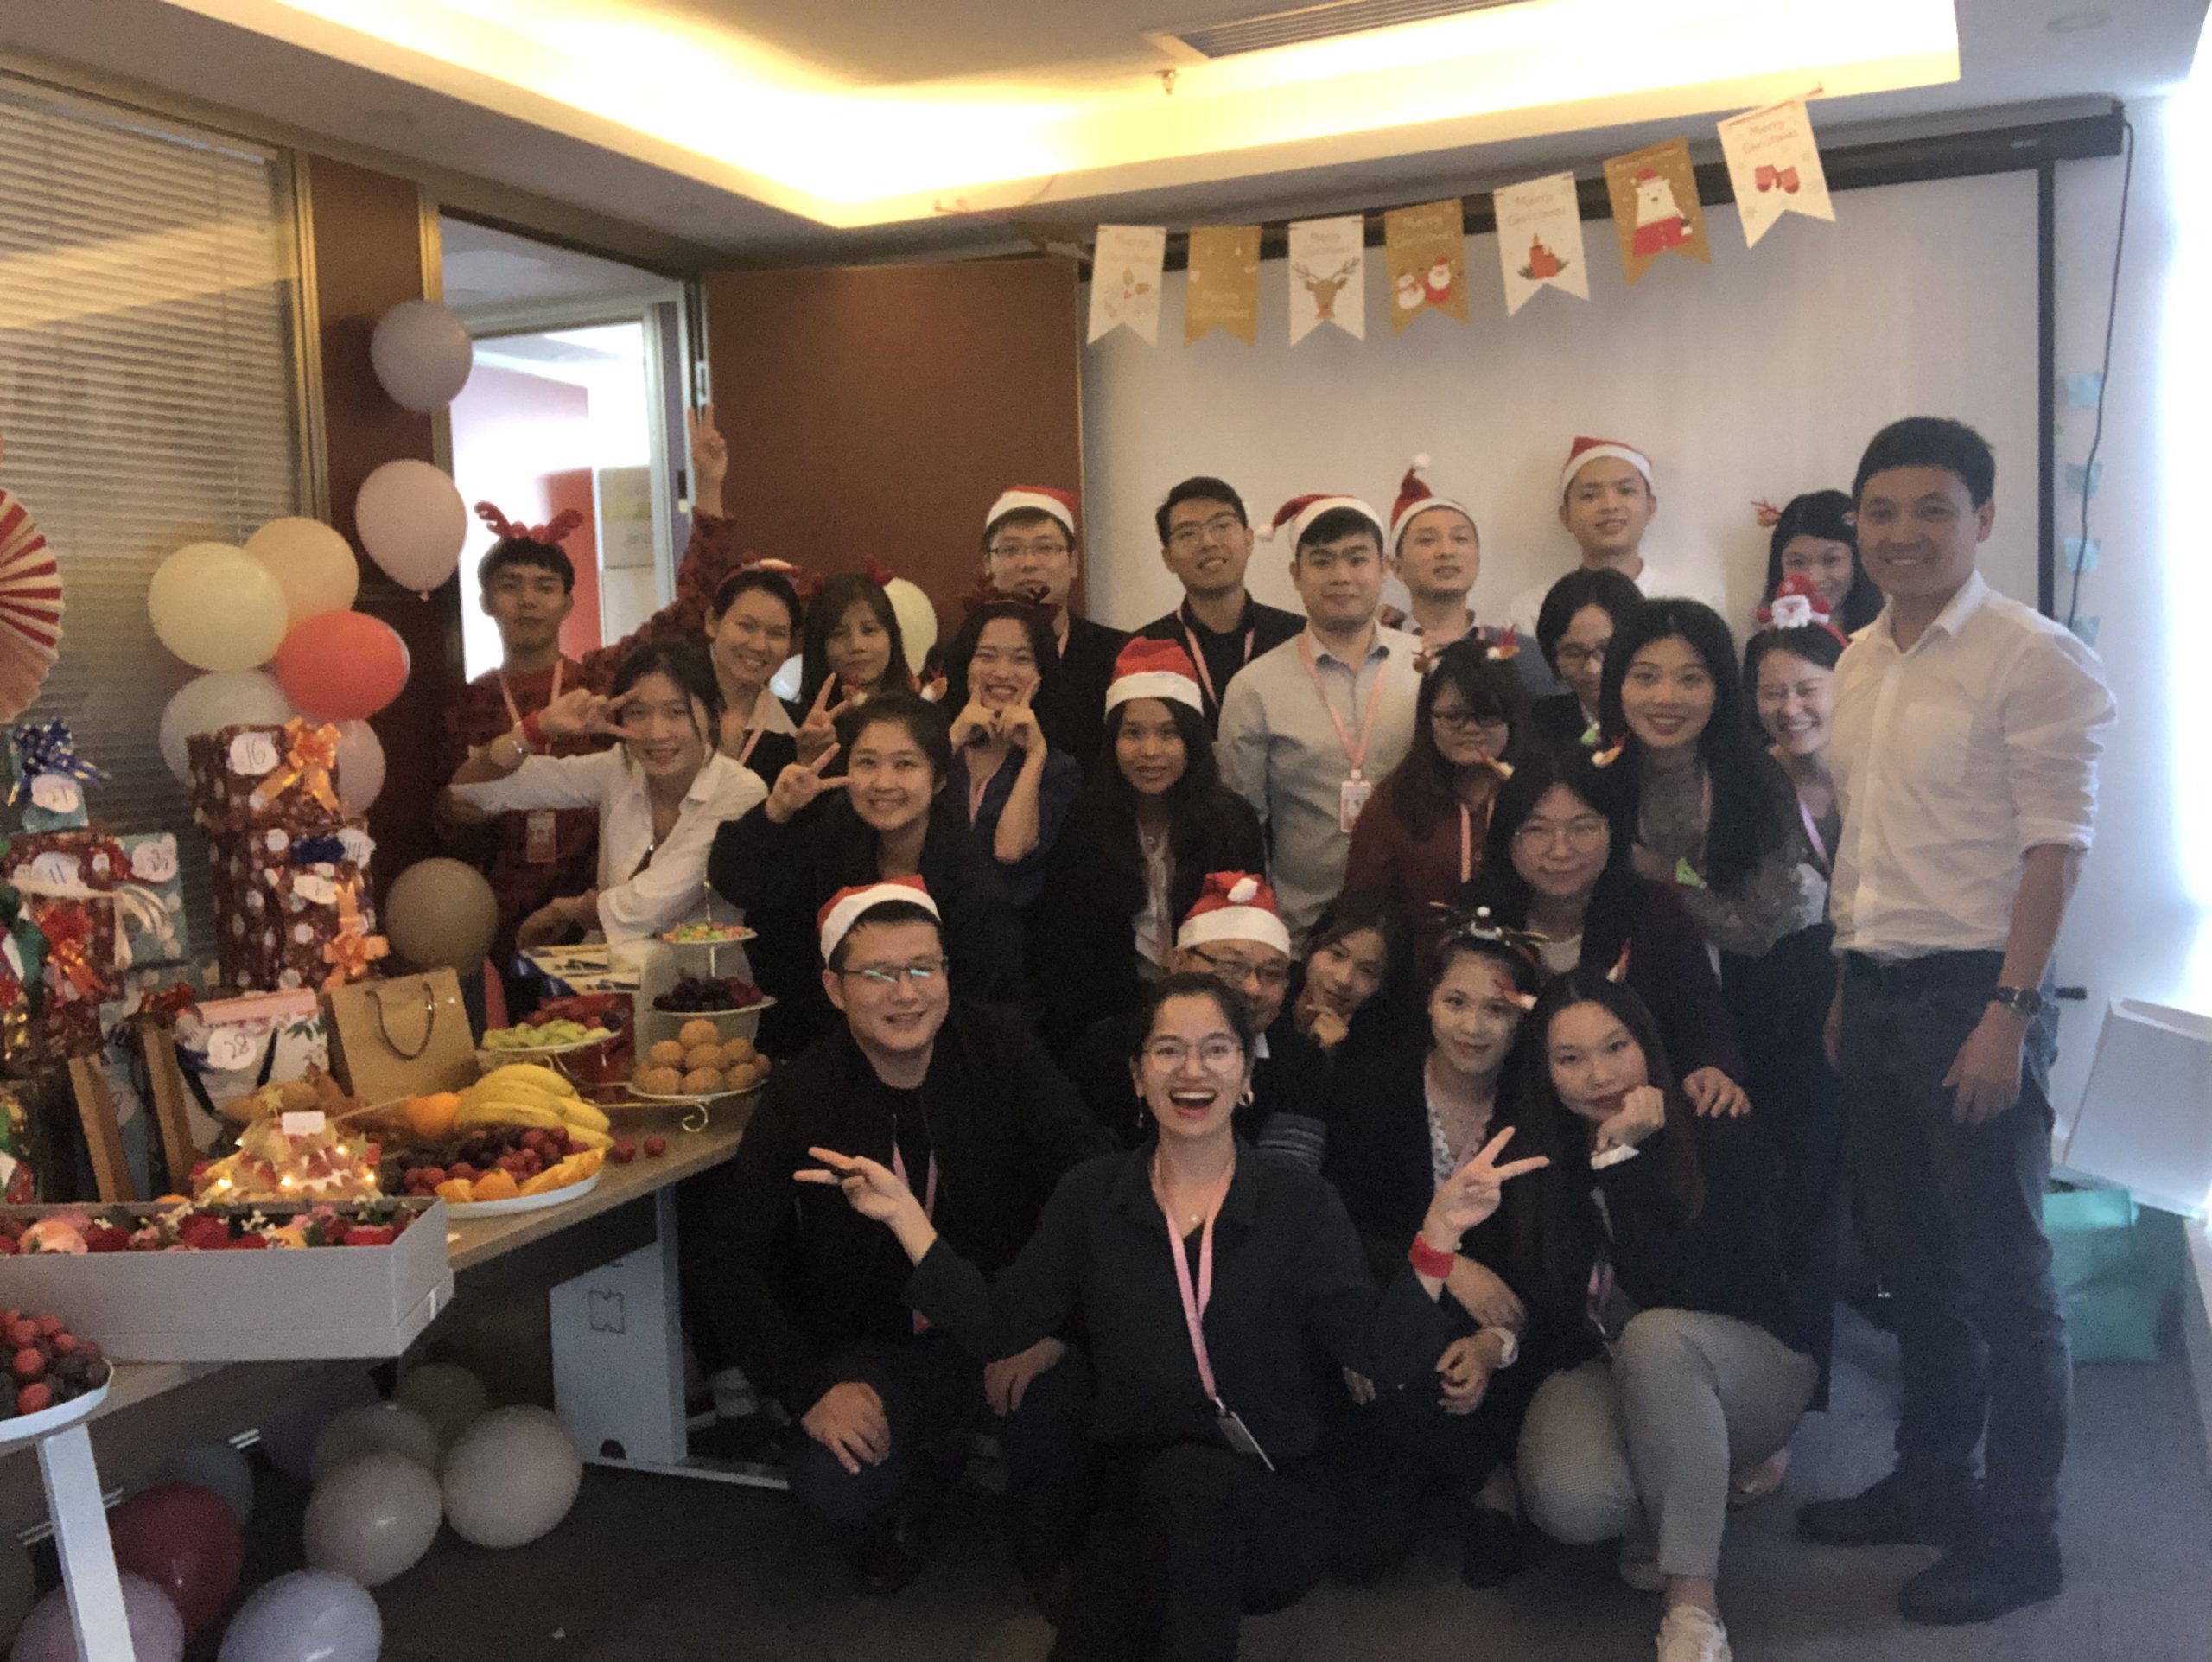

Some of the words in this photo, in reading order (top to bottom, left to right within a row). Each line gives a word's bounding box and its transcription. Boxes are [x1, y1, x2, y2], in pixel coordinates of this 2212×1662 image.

[1749, 120, 1785, 135] Merry
[245, 738, 266, 770] 16
[48, 863, 67, 885] 11
[224, 1034, 250, 1060] 28
